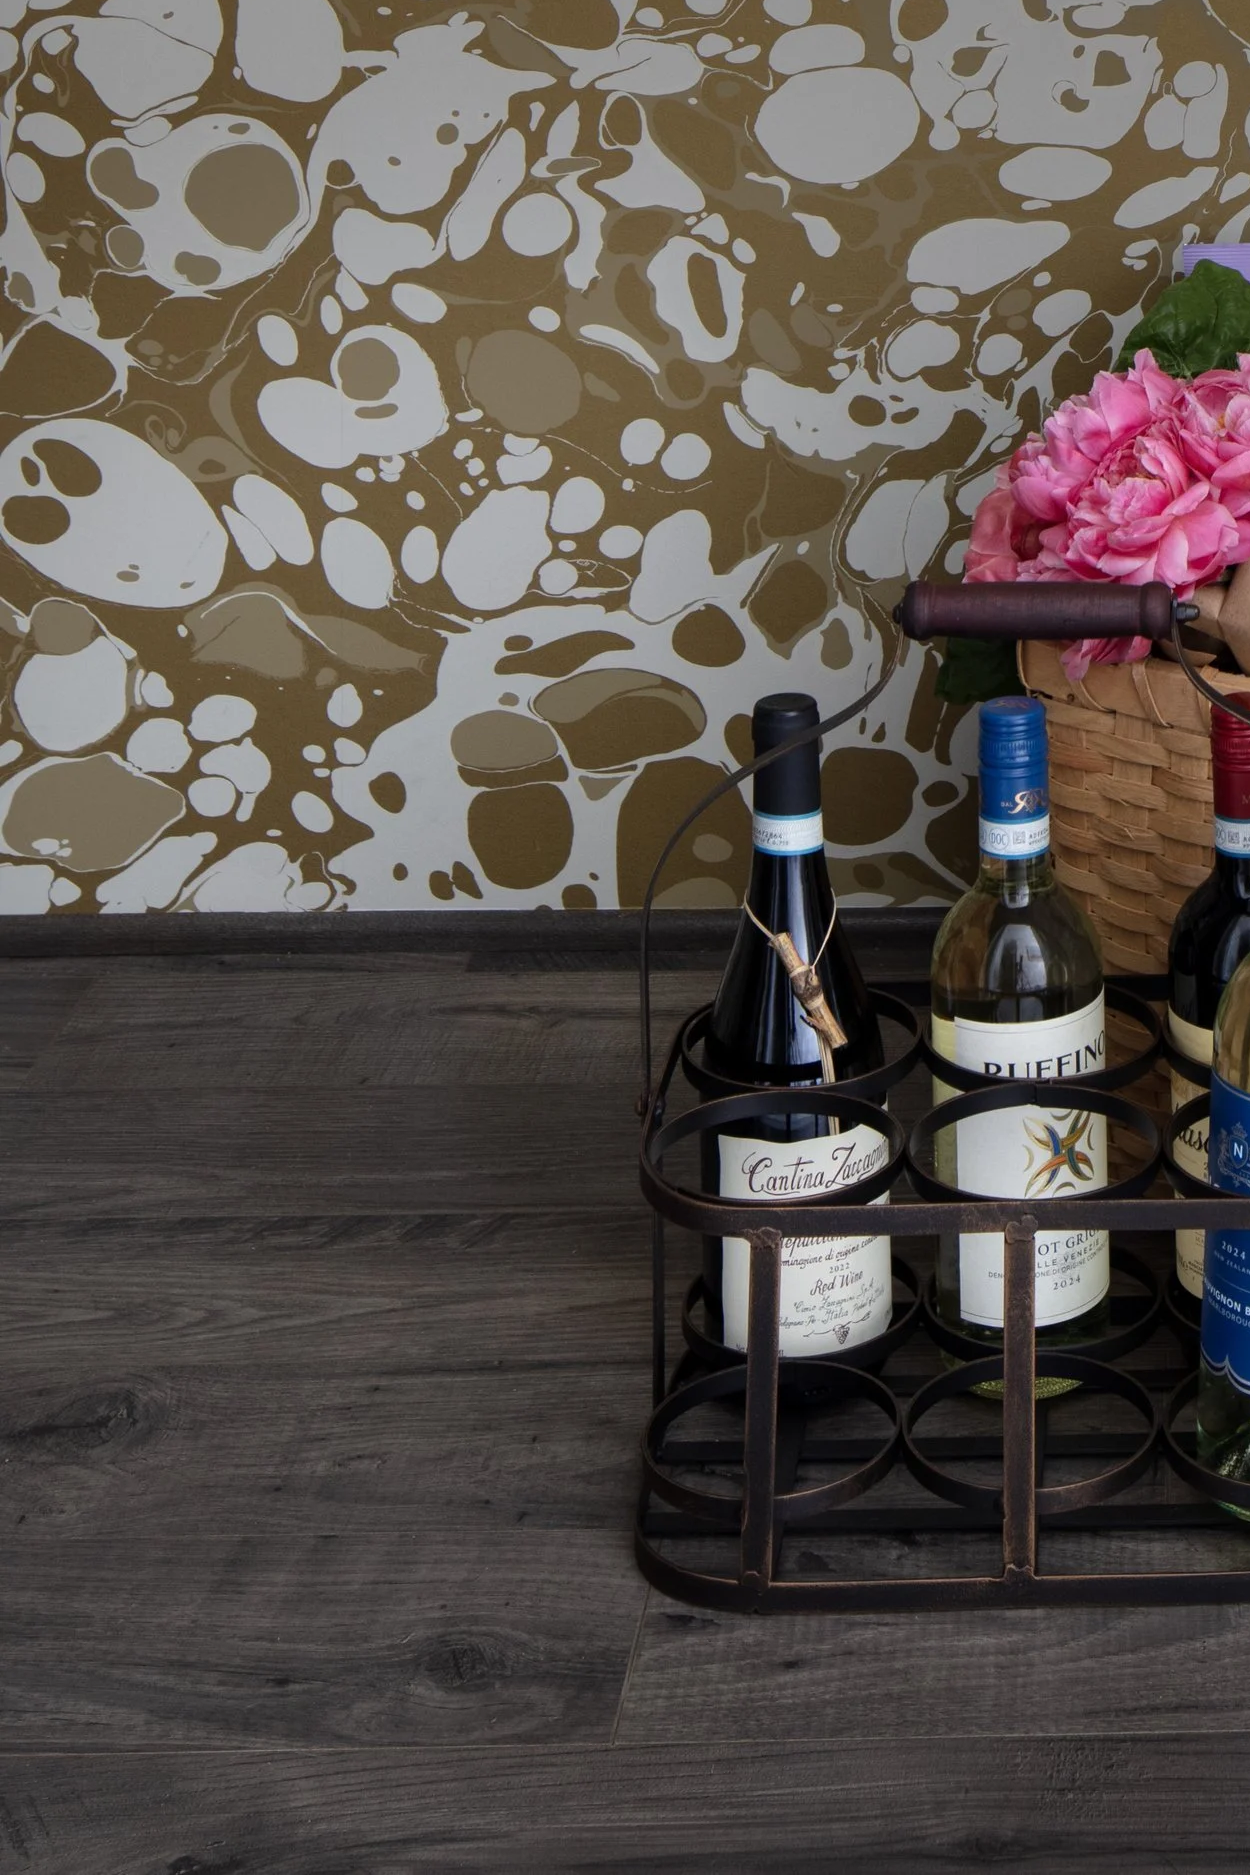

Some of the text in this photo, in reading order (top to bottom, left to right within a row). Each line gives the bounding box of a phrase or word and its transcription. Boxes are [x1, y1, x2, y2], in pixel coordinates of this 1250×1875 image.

[1233, 1142, 1244, 1158] N
[741, 1152, 825, 1196] Cantina
[1221, 1240, 1246, 1261] 2024
[828, 1262, 851, 1274] 2022
[809, 1270, 864, 1296] Red Wine
[1052, 1274, 1081, 1291] 2024
